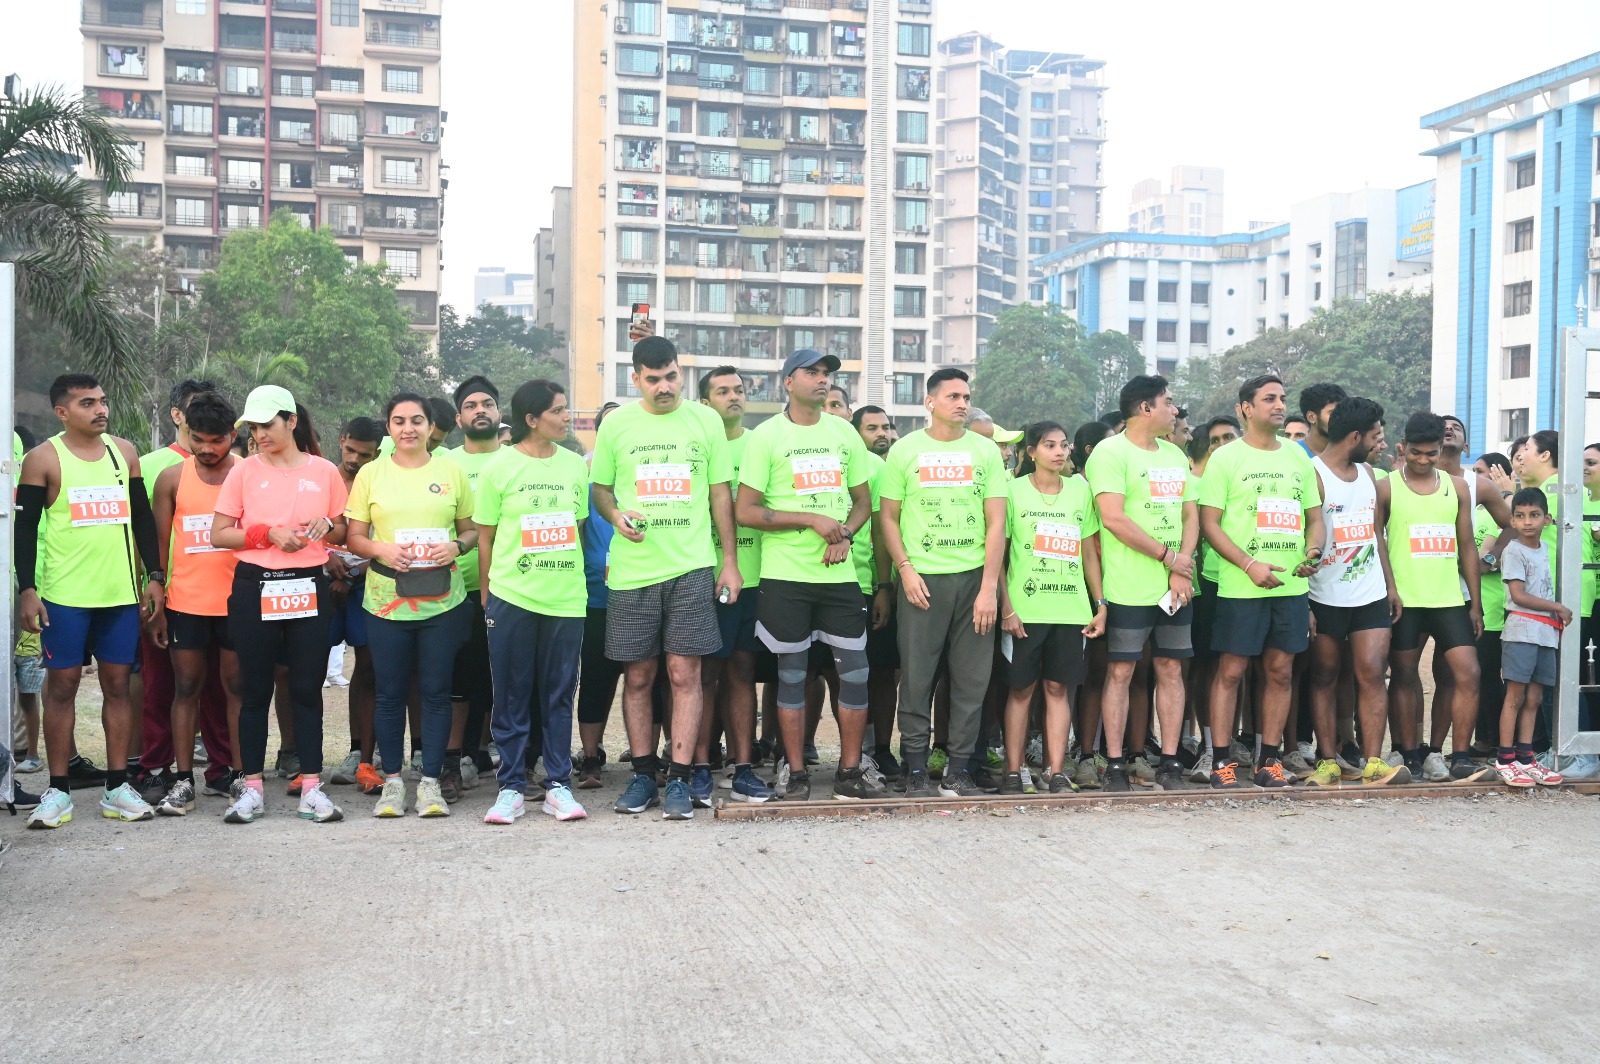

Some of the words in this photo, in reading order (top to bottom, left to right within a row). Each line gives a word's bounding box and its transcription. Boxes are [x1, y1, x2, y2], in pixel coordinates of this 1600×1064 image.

[639, 444, 677, 453] DECATHLON
[802, 472, 836, 486] 1063
[927, 467, 966, 479] 1062
[646, 480, 683, 492] 1102
[1156, 482, 1183, 494] 1009
[80, 502, 120, 517] 1108
[651, 519, 672, 527] JANYA
[674, 518, 691, 526] FARMS
[1266, 513, 1297, 527] 1050
[193, 531, 211, 544] 10
[531, 528, 568, 544] 1068
[1343, 525, 1371, 539] 1081
[937, 539, 957, 547] JANYA
[958, 538, 975, 546] FARMS
[1044, 537, 1077, 553] 1088
[1262, 541, 1281, 549] JANYA
[1419, 539, 1451, 550] 1117
[535, 559, 556, 568] JANYA
[558, 560, 575, 569] FARMS
[1040, 583, 1059, 592] JANYA
[270, 594, 310, 611] 1099
